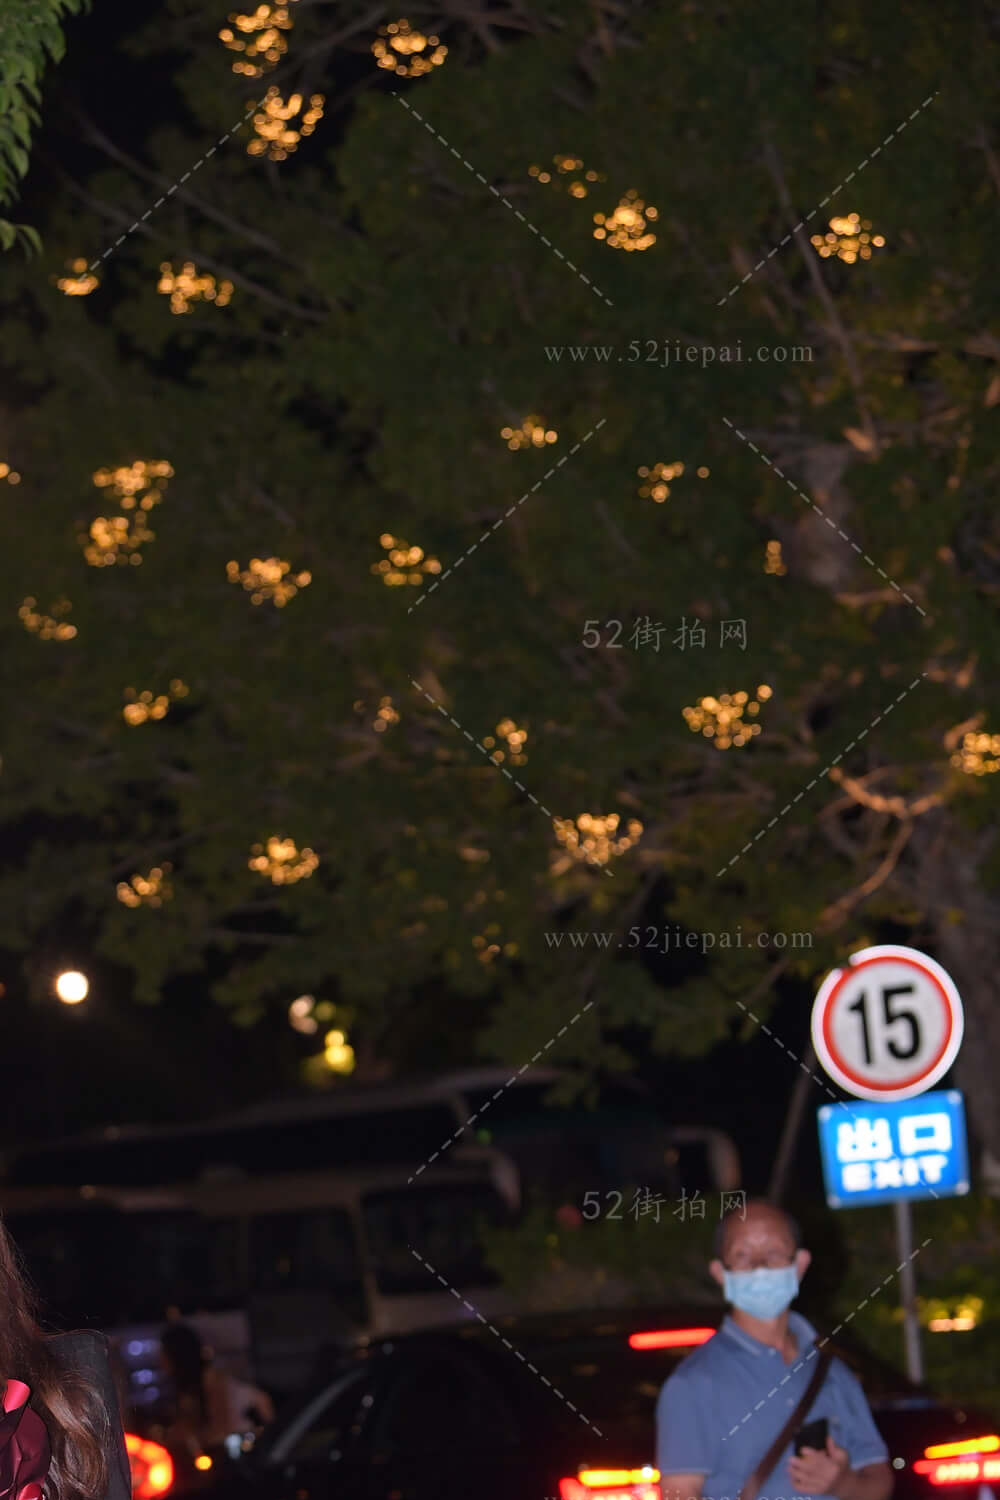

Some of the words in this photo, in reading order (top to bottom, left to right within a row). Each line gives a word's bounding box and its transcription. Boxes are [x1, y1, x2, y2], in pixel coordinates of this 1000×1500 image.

[848, 983, 922, 1066] 15
[836, 1112, 953, 1164] 出口
[841, 1154, 949, 1193] EXIT
